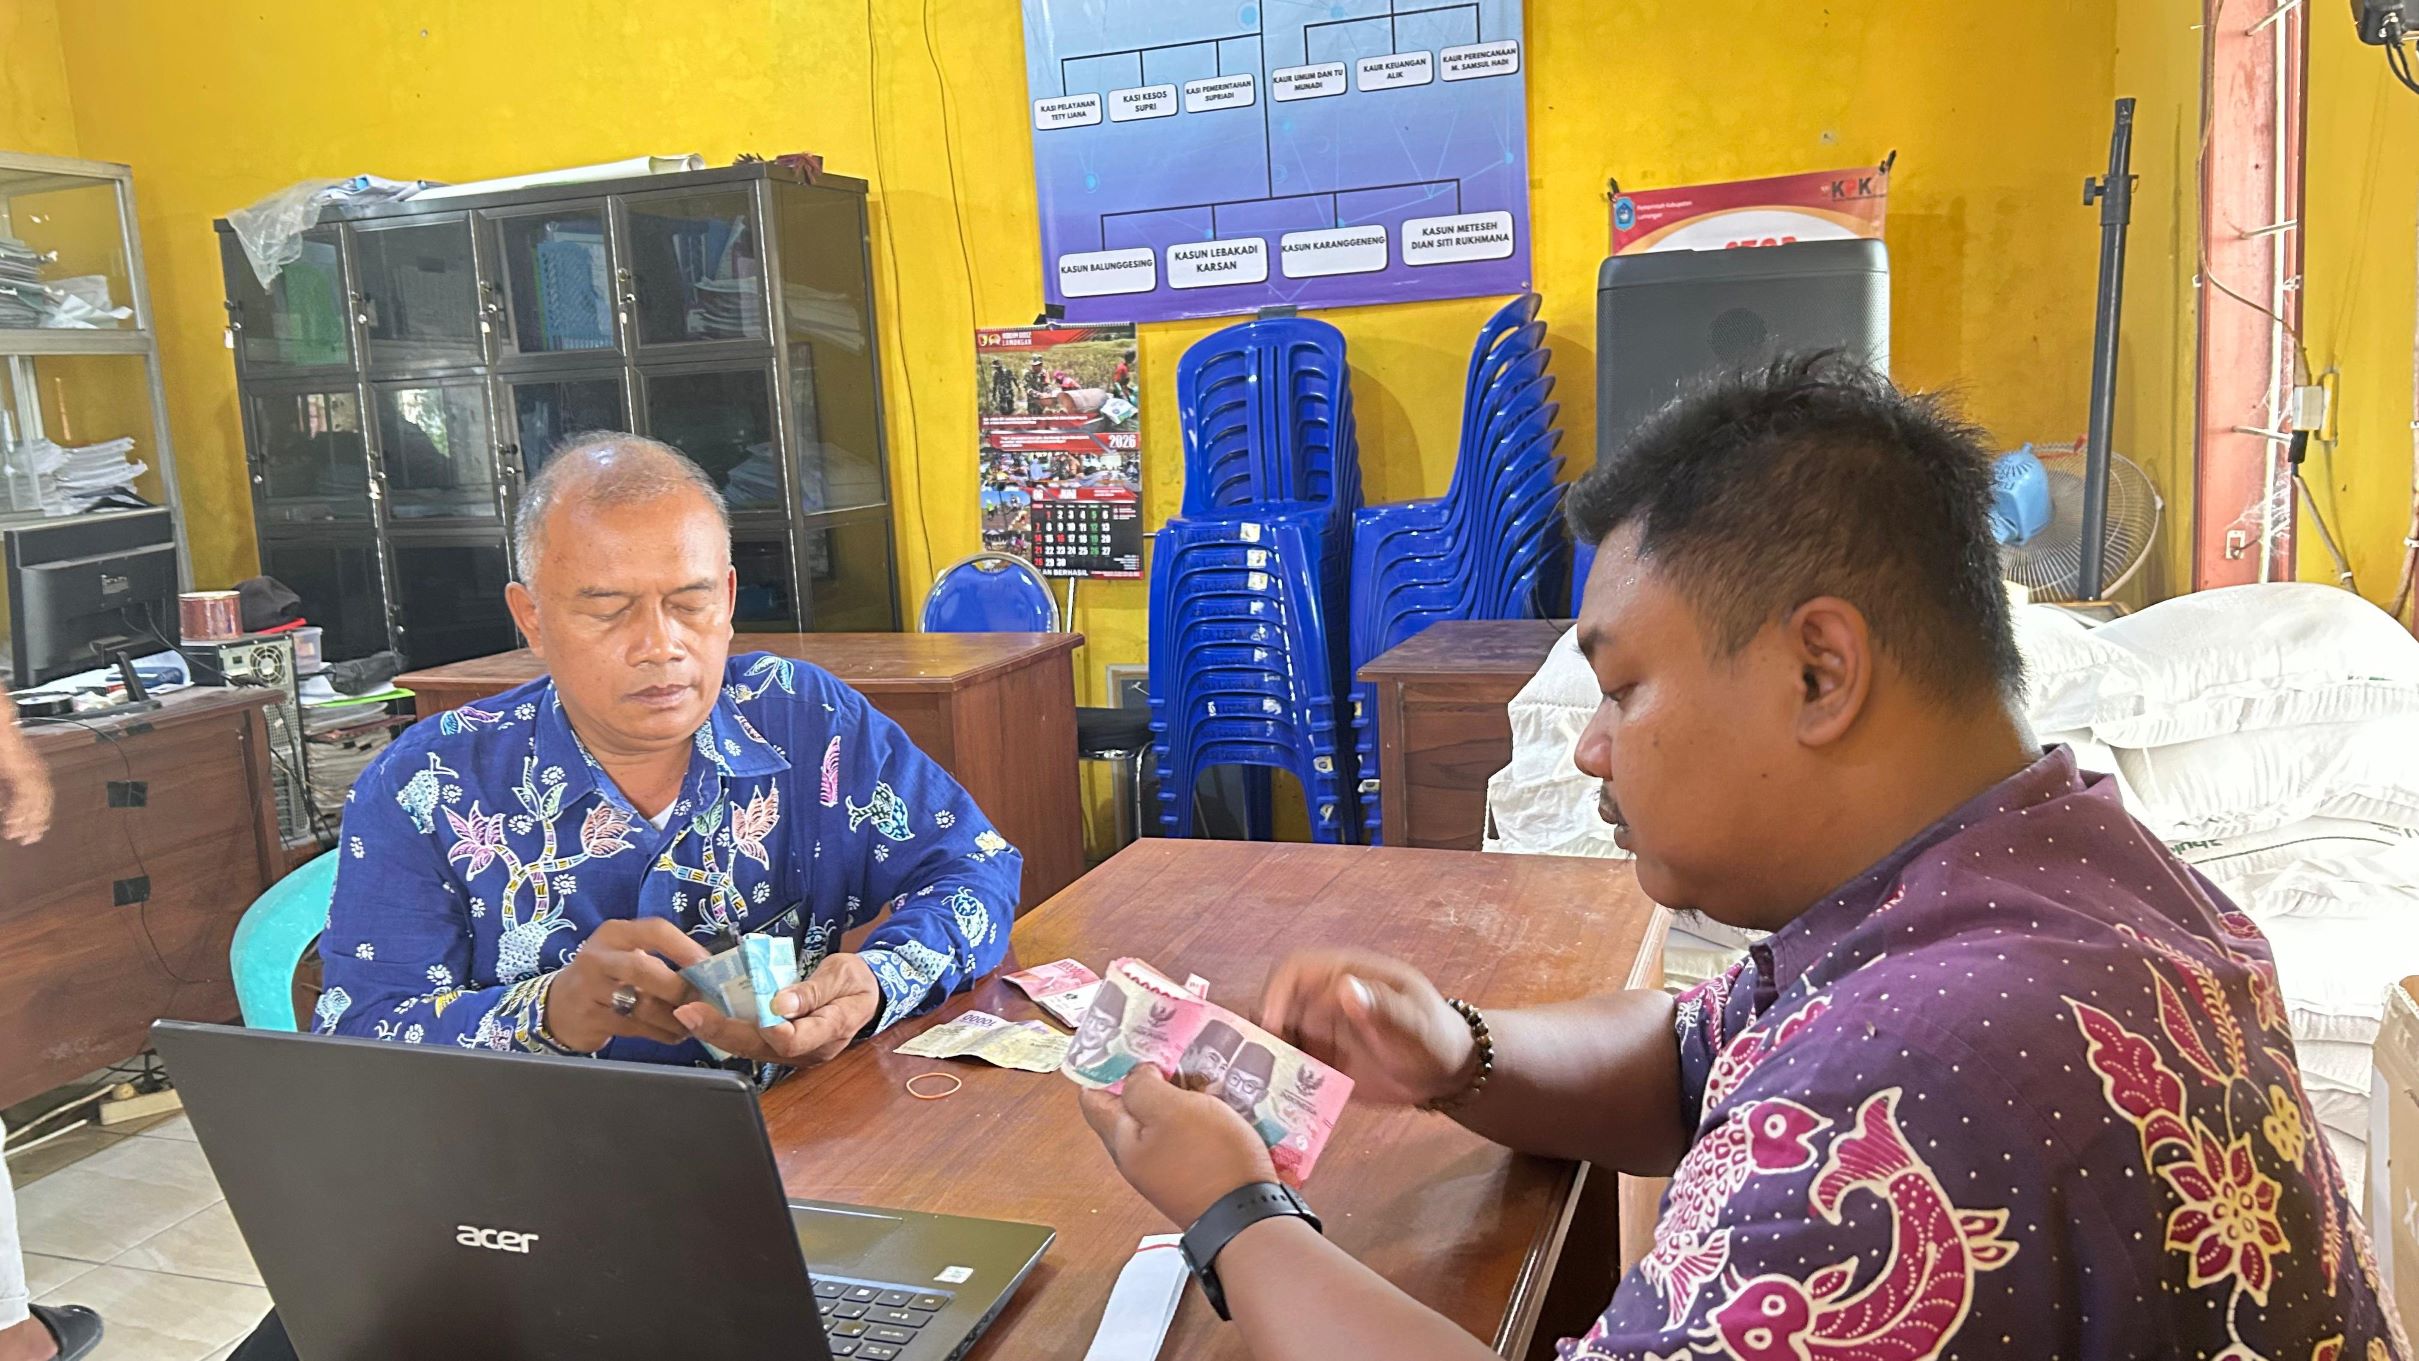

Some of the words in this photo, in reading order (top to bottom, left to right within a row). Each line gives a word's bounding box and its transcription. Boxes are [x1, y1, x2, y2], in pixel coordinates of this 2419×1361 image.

[1443, 53, 1463, 63] KAUR
[1464, 47, 1517, 61] PERENCANAAN
[1363, 63, 1384, 73] KAUR
[1385, 58, 1426, 70] KEUANGAN
[1451, 63, 1460, 72] M.
[1461, 60, 1490, 70] SAMSUL
[1491, 58, 1509, 67] HADI
[1273, 72, 1293, 84] KAUR
[1294, 70, 1316, 82] UMUM
[1317, 69, 1333, 80] DAN
[1333, 68, 1343, 78] TU
[1387, 71, 1404, 80] ALIK
[1186, 87, 1201, 96] KASI
[1202, 81, 1252, 94] PEMERINTAHAN
[1294, 82, 1323, 92] MUNADI
[1123, 94, 1141, 103] KASI
[1142, 91, 1168, 101] KESOS
[1204, 92, 1235, 102] SUPRIADI
[1040, 104, 1057, 113] KASI
[1057, 100, 1096, 112] PELAYANAN
[1135, 104, 1157, 113] SUPRI
[1051, 112, 1067, 121] TETY
[1067, 110, 1087, 120] LIANA
[1422, 226, 1455, 237] KASUN
[1456, 221, 1498, 233] METESEH
[1282, 242, 1312, 253] KASUN
[1313, 236, 1385, 250] KARANGGENENG
[1411, 239, 1435, 250] DIAN
[1436, 238, 1453, 248] SITI
[1454, 233, 1509, 246] RUKHMANA
[1175, 250, 1208, 261] KASUN
[1210, 245, 1258, 258] LEBAKADI
[1061, 264, 1089, 274] KASUN
[1090, 259, 1153, 271] BALUNGGESING
[1197, 261, 1237, 273] KARSAN
[1109, 434, 1137, 448] 2026
[1045, 510, 1052, 520] 1
[1057, 510, 1063, 520] 2
[1067, 510, 1074, 520] 3
[1079, 510, 1086, 520] 4
[1091, 510, 1097, 520] 5
[1102, 510, 1109, 520] 6
[1045, 522, 1052, 532] 8
[1057, 522, 1064, 532] 9
[1066, 522, 1076, 532] 10
[1079, 522, 1087, 532] 11
[1090, 522, 1098, 532] 12
[1101, 522, 1110, 532] 13
[1067, 533, 1076, 543] 17
[1044, 546, 1055, 556] 22
[1067, 546, 1077, 556] 24
[1078, 546, 1088, 556] 25
[1101, 546, 1111, 556] 27
[456, 1225, 539, 1253] acer
